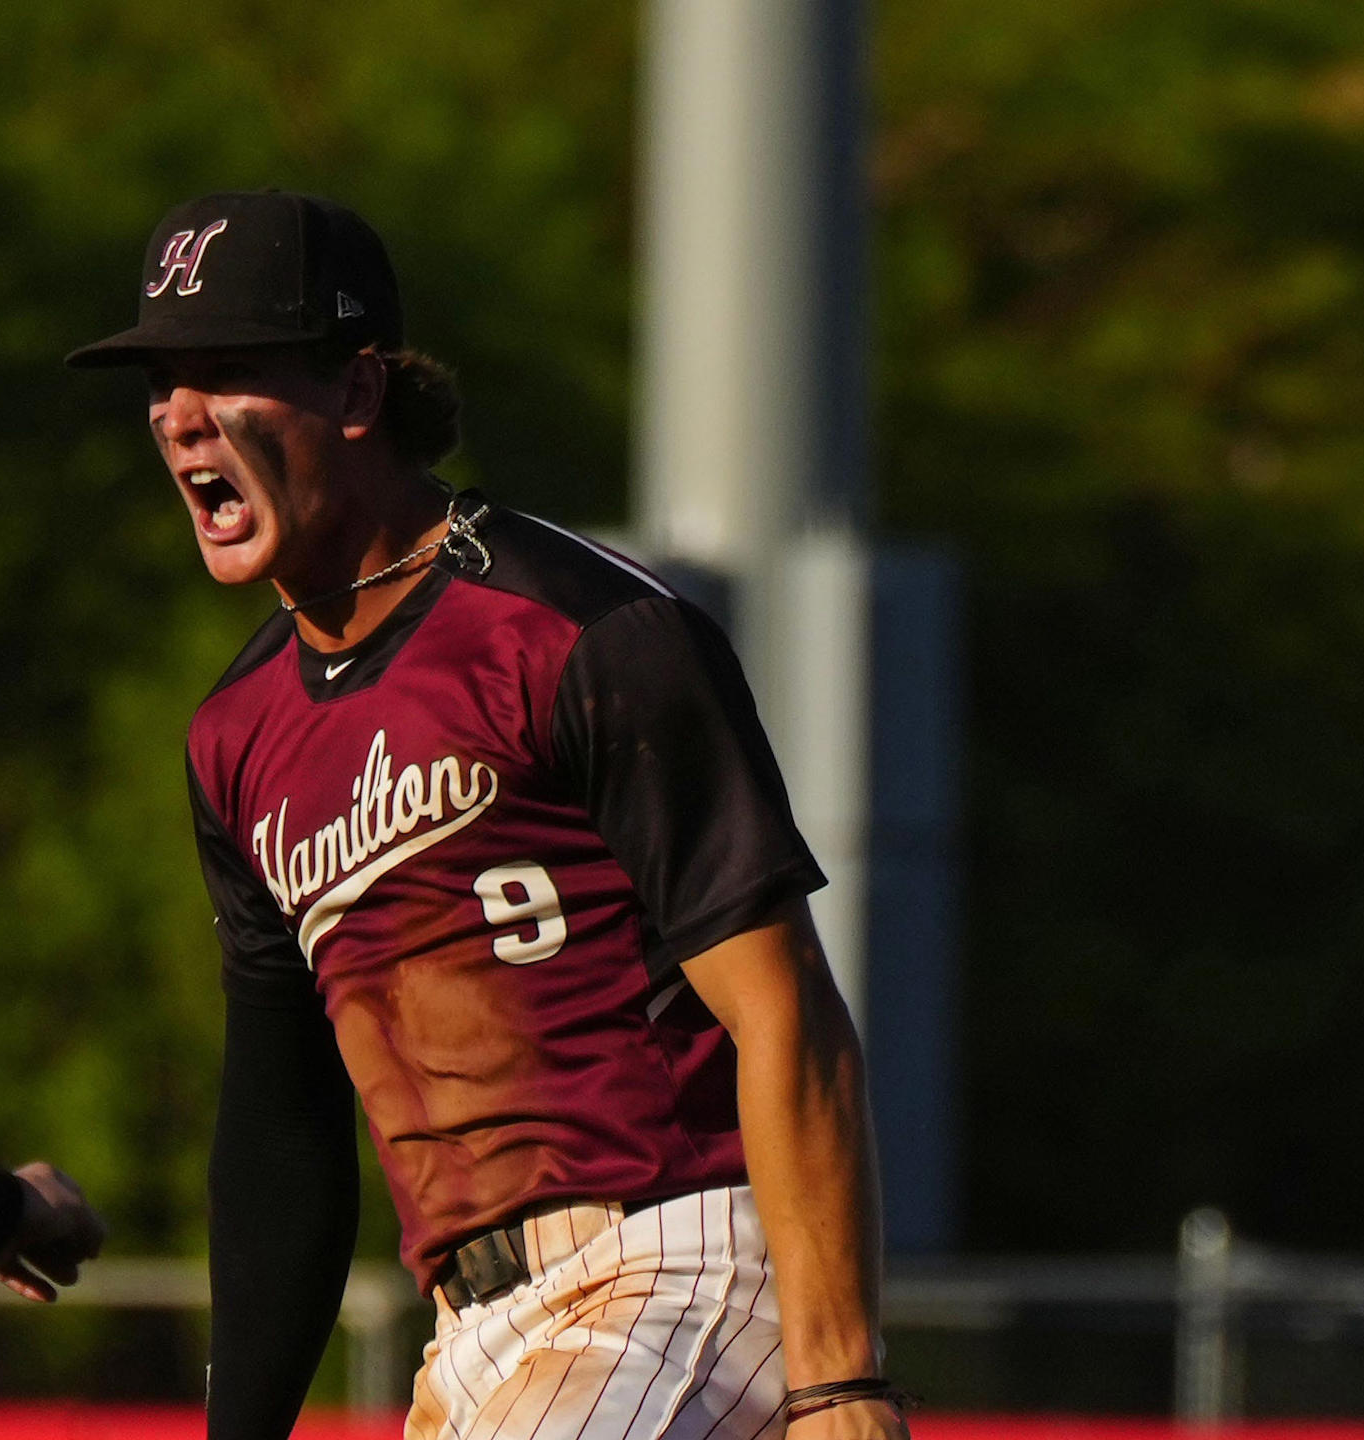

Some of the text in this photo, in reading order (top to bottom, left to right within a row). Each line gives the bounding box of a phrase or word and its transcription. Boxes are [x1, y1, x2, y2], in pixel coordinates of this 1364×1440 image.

[146, 219, 228, 298] H
[252, 729, 498, 918] Hamilton
[473, 860, 568, 965] 9
